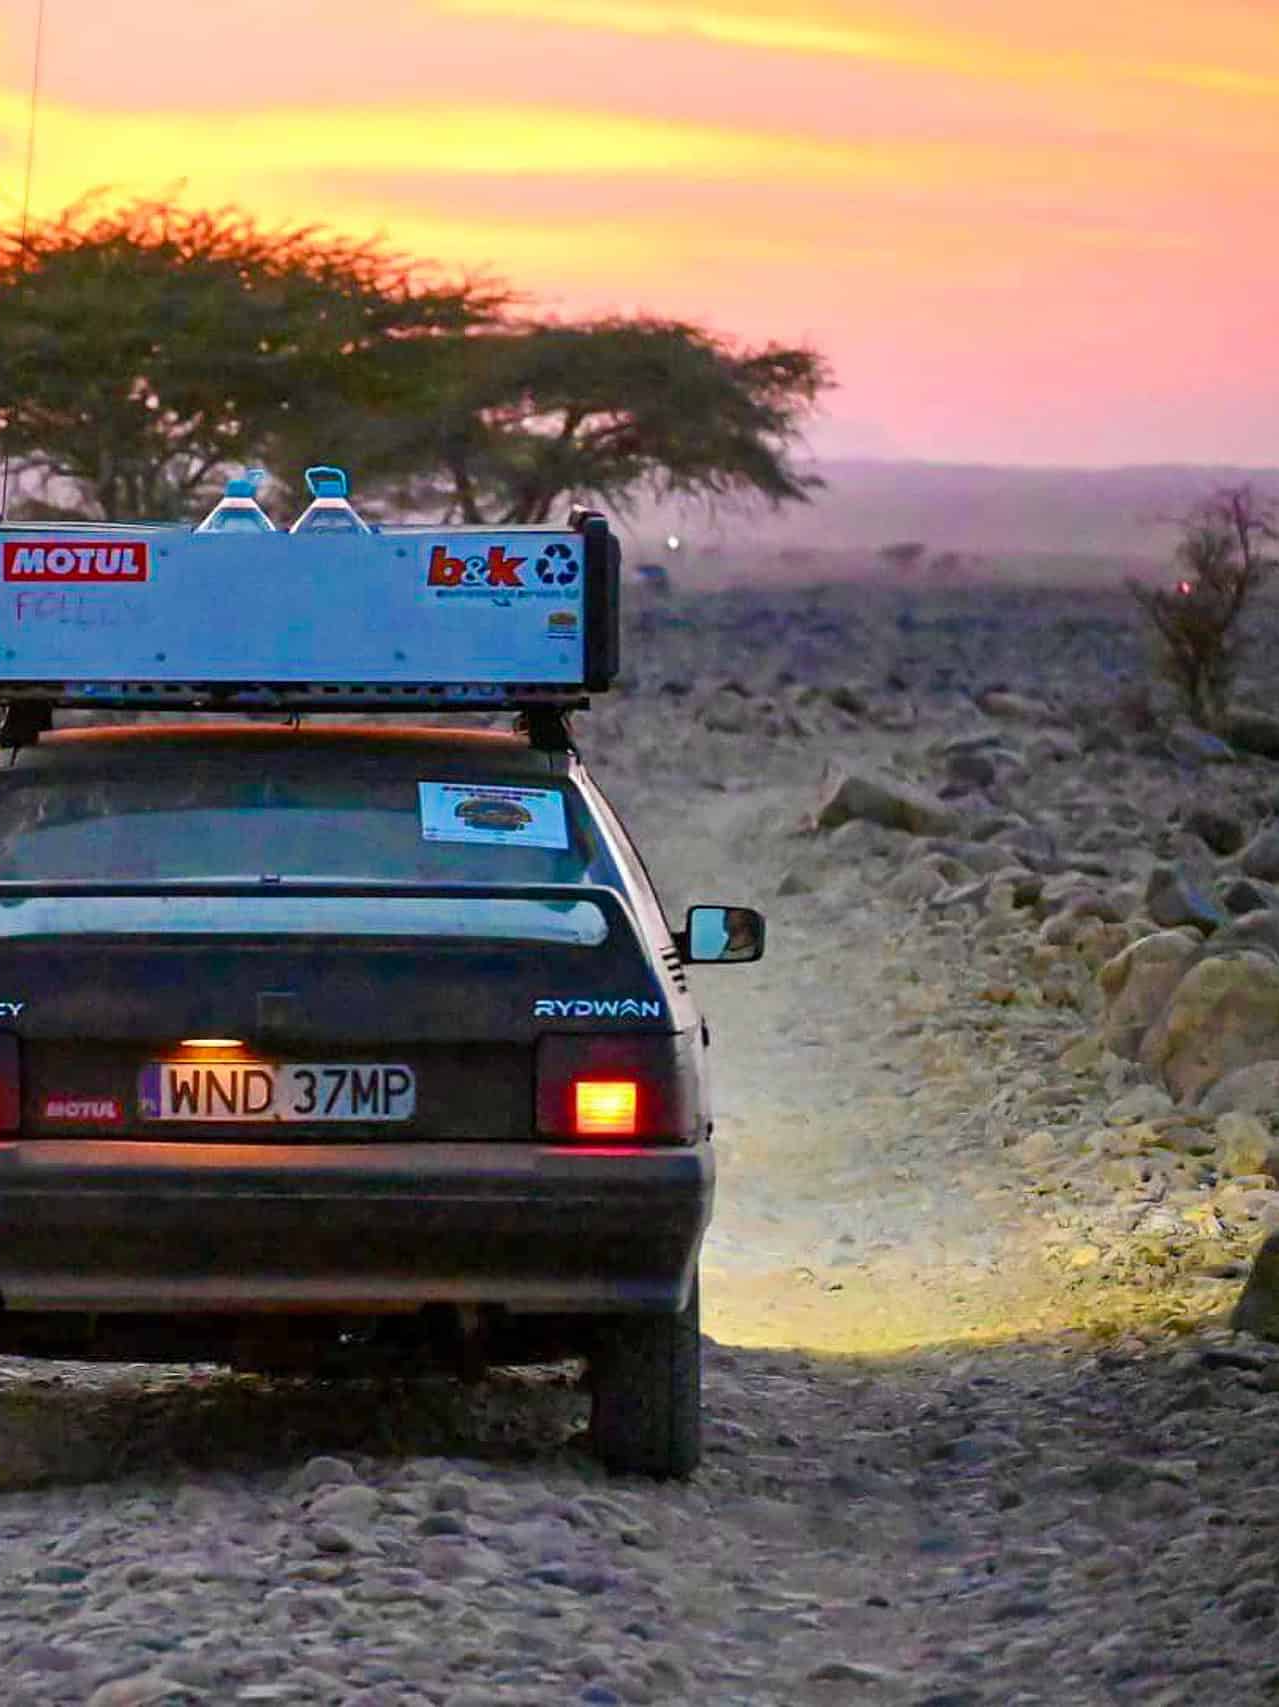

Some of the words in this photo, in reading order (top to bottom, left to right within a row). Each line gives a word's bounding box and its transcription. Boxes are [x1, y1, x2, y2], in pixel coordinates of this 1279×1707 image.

[11, 548, 138, 574] MOTUL
[427, 545, 528, 587] b&k
[534, 999, 660, 1016] RYDWAN
[170, 1069, 272, 1114] WND
[293, 1068, 410, 1114] 37MP
[47, 1101, 117, 1118] MOTUL
